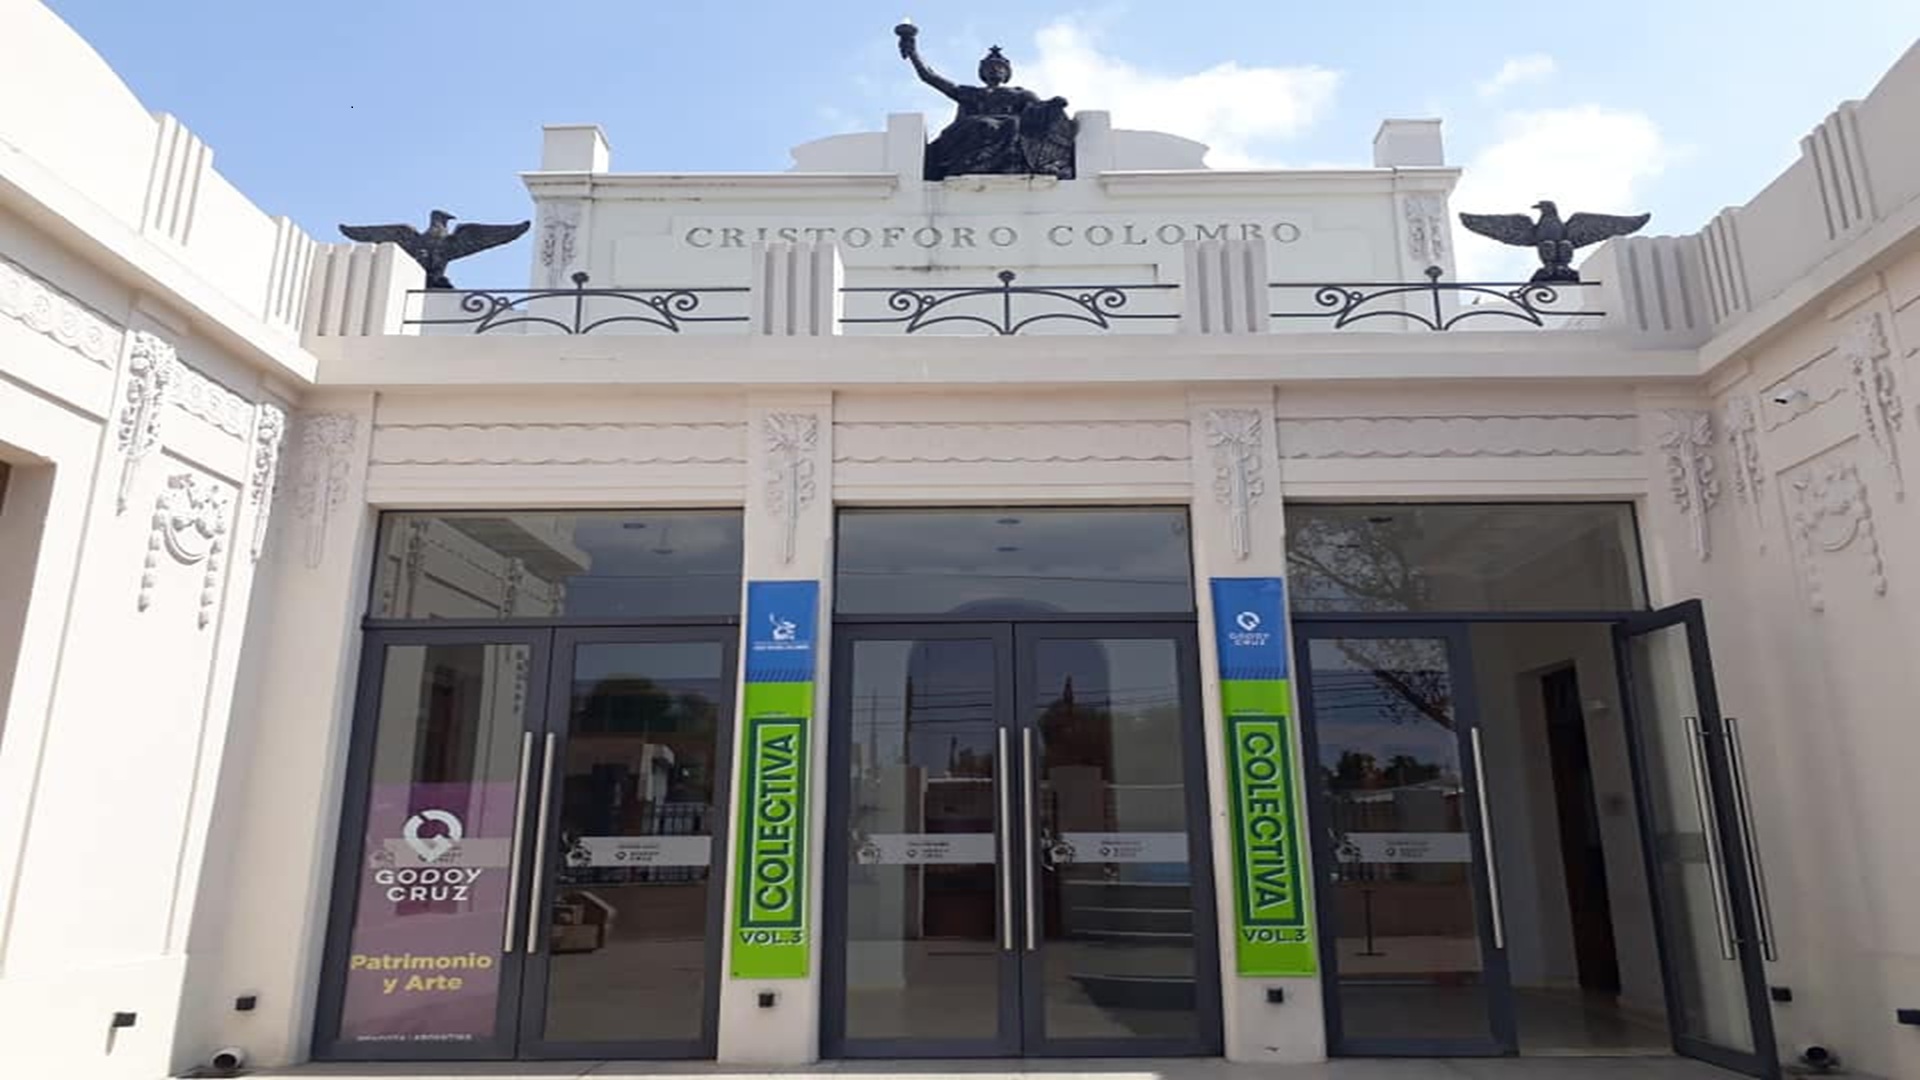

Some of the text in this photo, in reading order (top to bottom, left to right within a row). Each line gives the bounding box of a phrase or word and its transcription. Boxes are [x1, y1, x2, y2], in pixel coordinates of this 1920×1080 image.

[685, 222, 1301, 248] CRISTOFORO COLOMBO
[757, 734, 796, 912] COLECTIVA
[1243, 731, 1289, 910] COLECTIVA
[375, 868, 482, 885] GODOY
[386, 885, 469, 902] CRUZ
[740, 929, 805, 945] VOL.3
[1244, 928, 1308, 943] VOL.3
[351, 953, 493, 970] Patrimonio
[383, 974, 463, 994] y Arte
